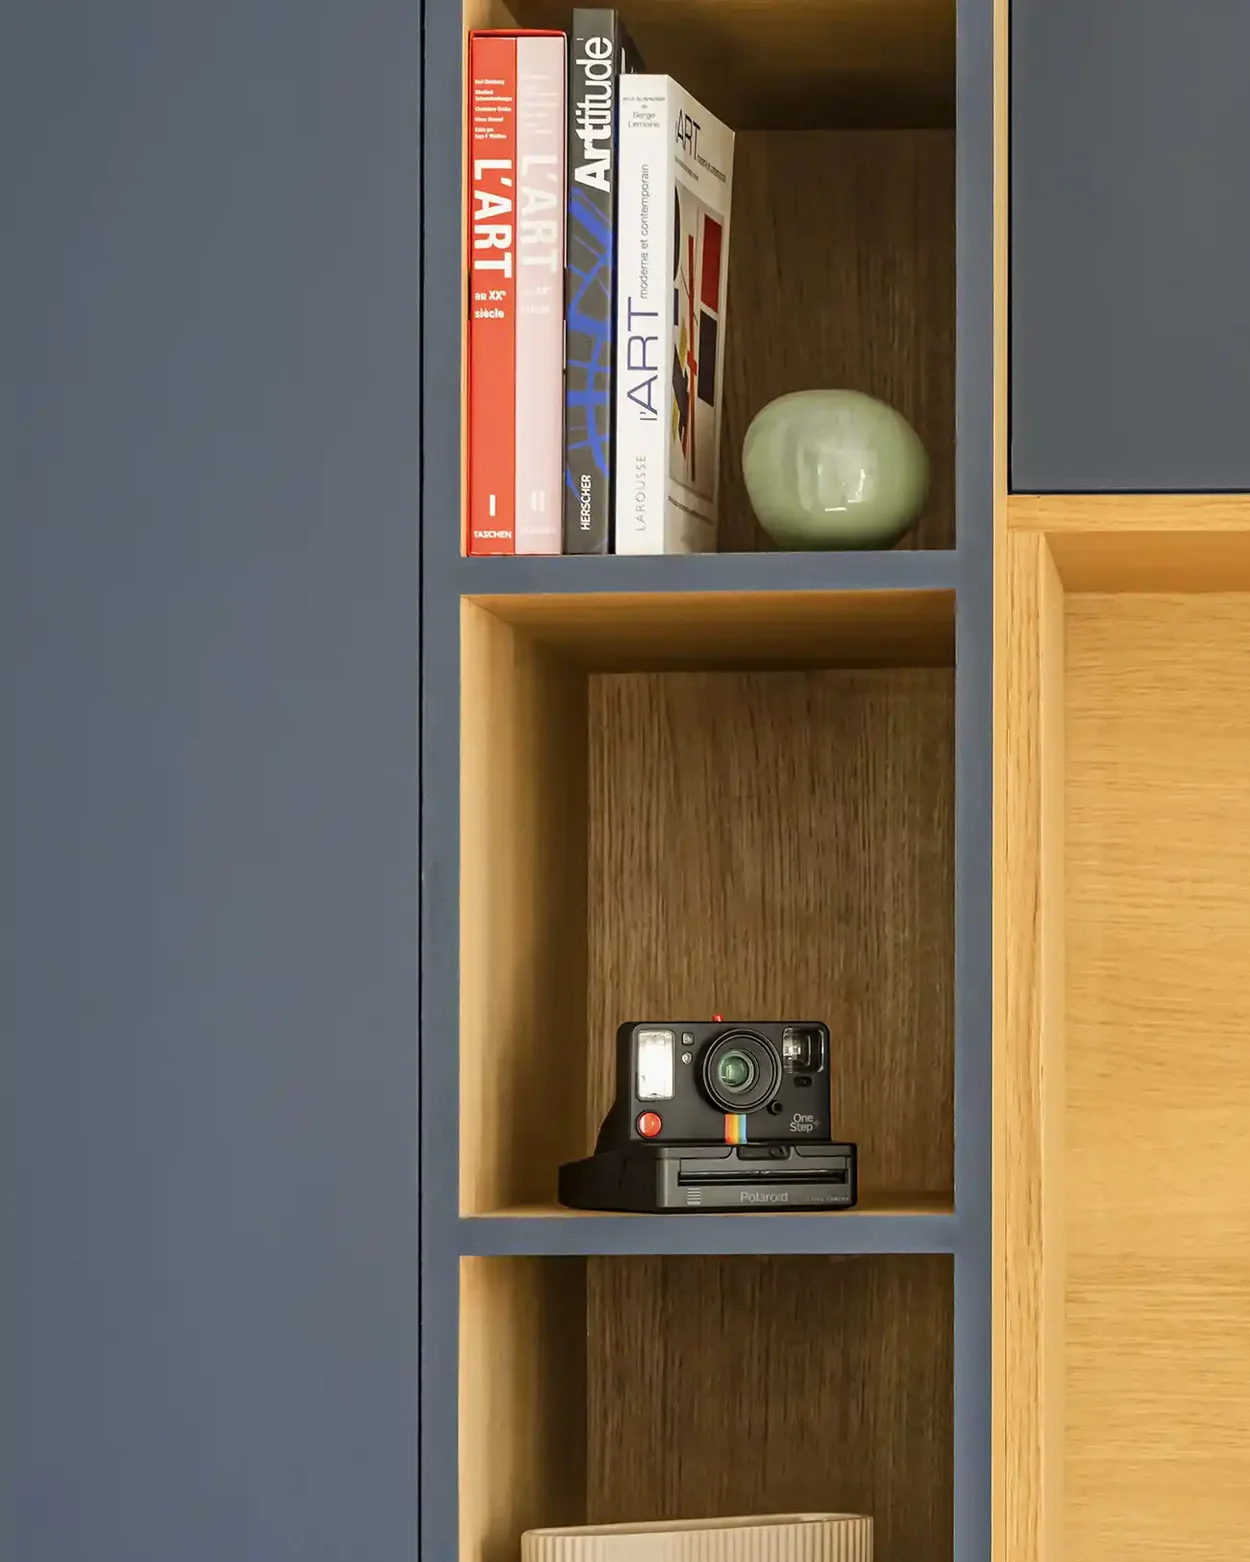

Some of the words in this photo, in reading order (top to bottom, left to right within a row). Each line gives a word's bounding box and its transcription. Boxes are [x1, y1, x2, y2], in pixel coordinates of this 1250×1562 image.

[575, 37, 613, 194] Artitude
[474, 159, 513, 278] L'ART
[520, 154, 558, 274] L'ART
[639, 164, 650, 234] contemporain
[641, 236, 649, 249] et
[474, 292, 487, 301] au
[640, 252, 649, 299] moderne
[474, 308, 505, 319] siècle
[580, 474, 592, 531] HERSCHER
[635, 455, 647, 531] LAROUSSE
[474, 530, 512, 539] TASCHEN
[793, 1113, 814, 1123] One
[740, 1191, 788, 1202] Polaroid
